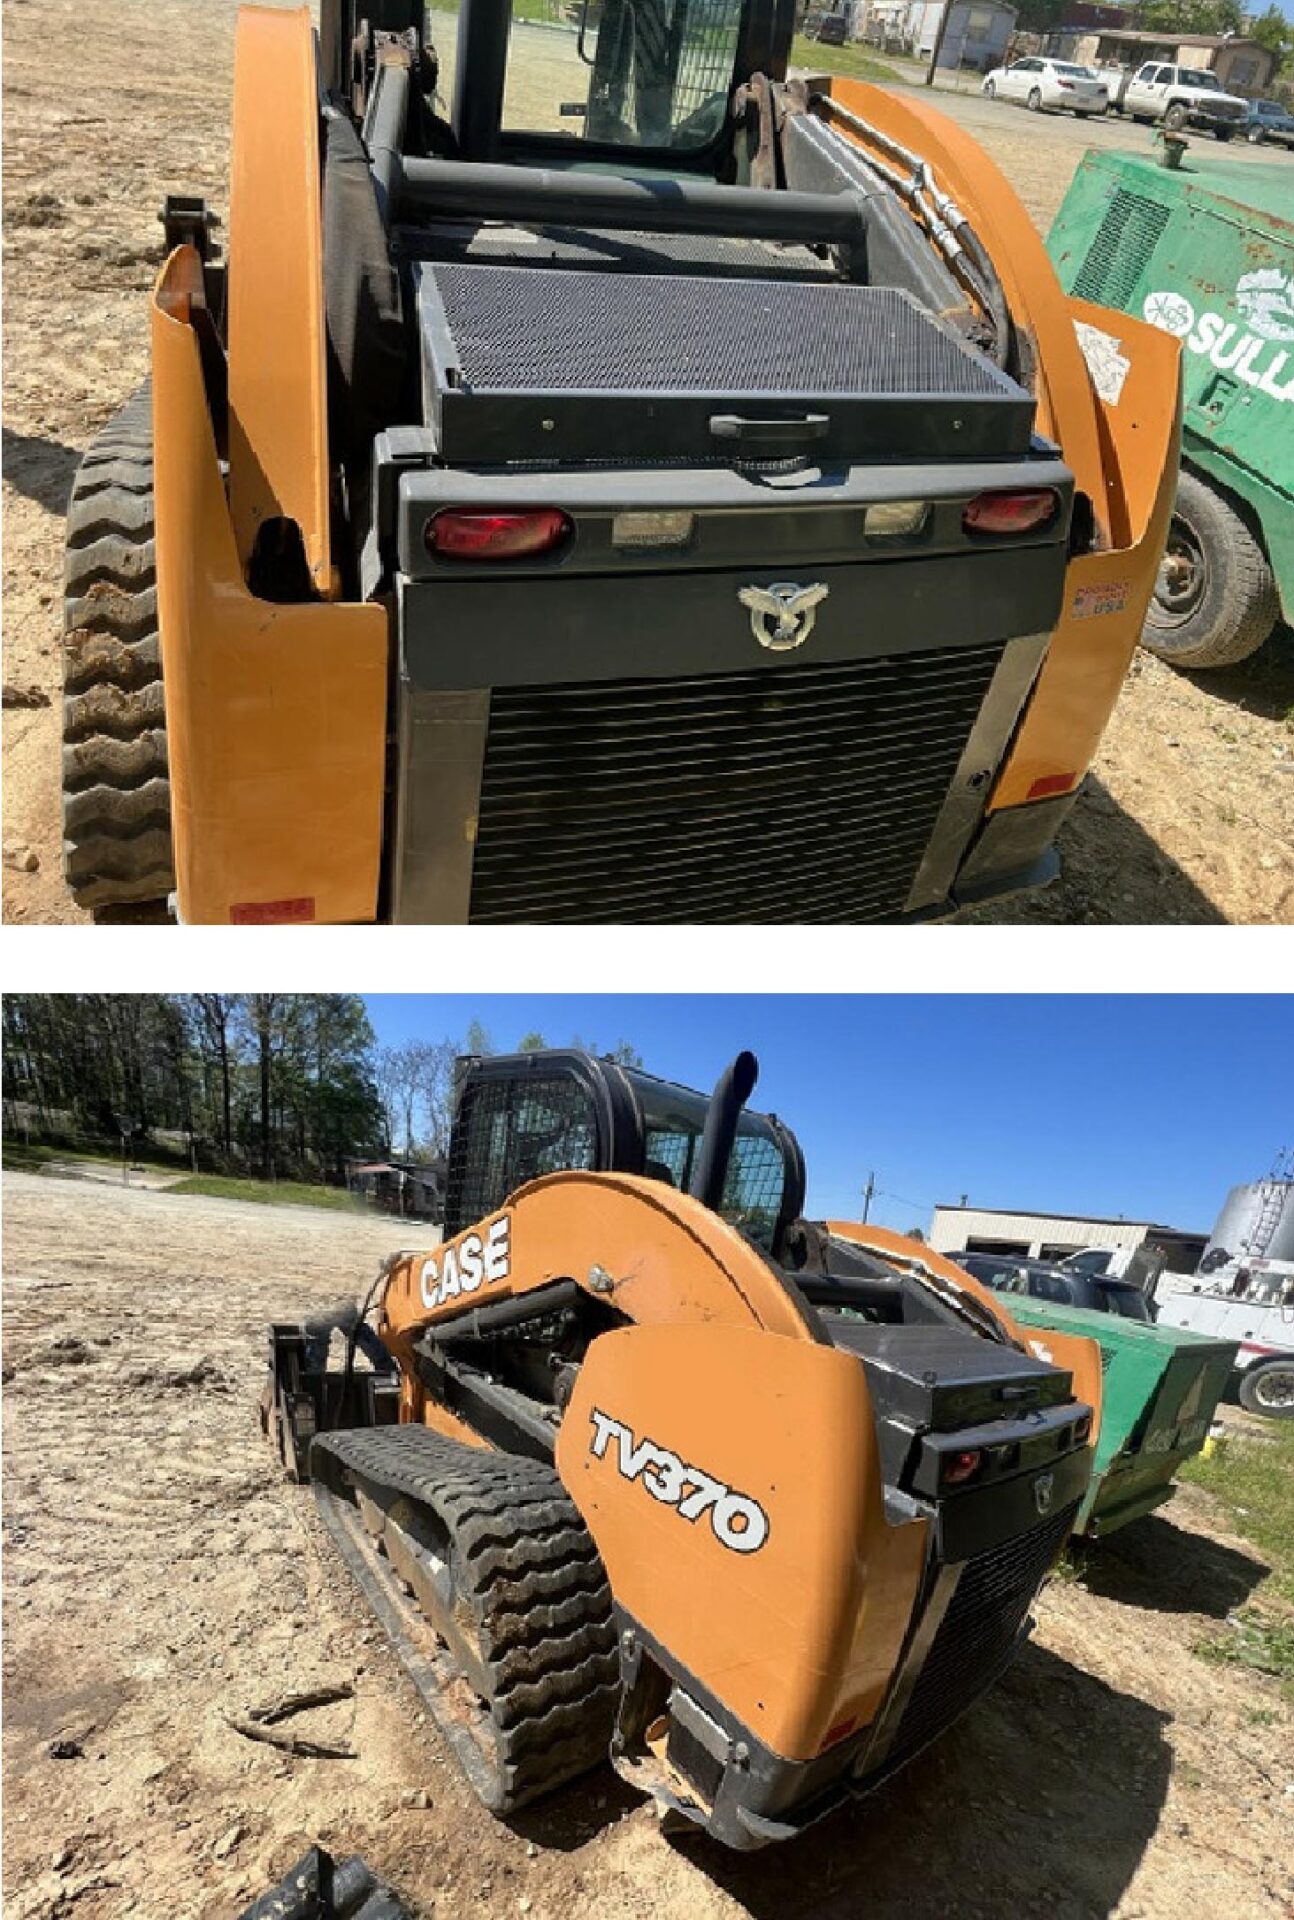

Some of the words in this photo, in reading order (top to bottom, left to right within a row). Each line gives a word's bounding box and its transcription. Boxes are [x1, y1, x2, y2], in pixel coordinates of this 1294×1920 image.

[1188, 312, 1294, 402] SULL
[420, 1214, 511, 1309] CASE
[589, 1406, 770, 1555] TV370
